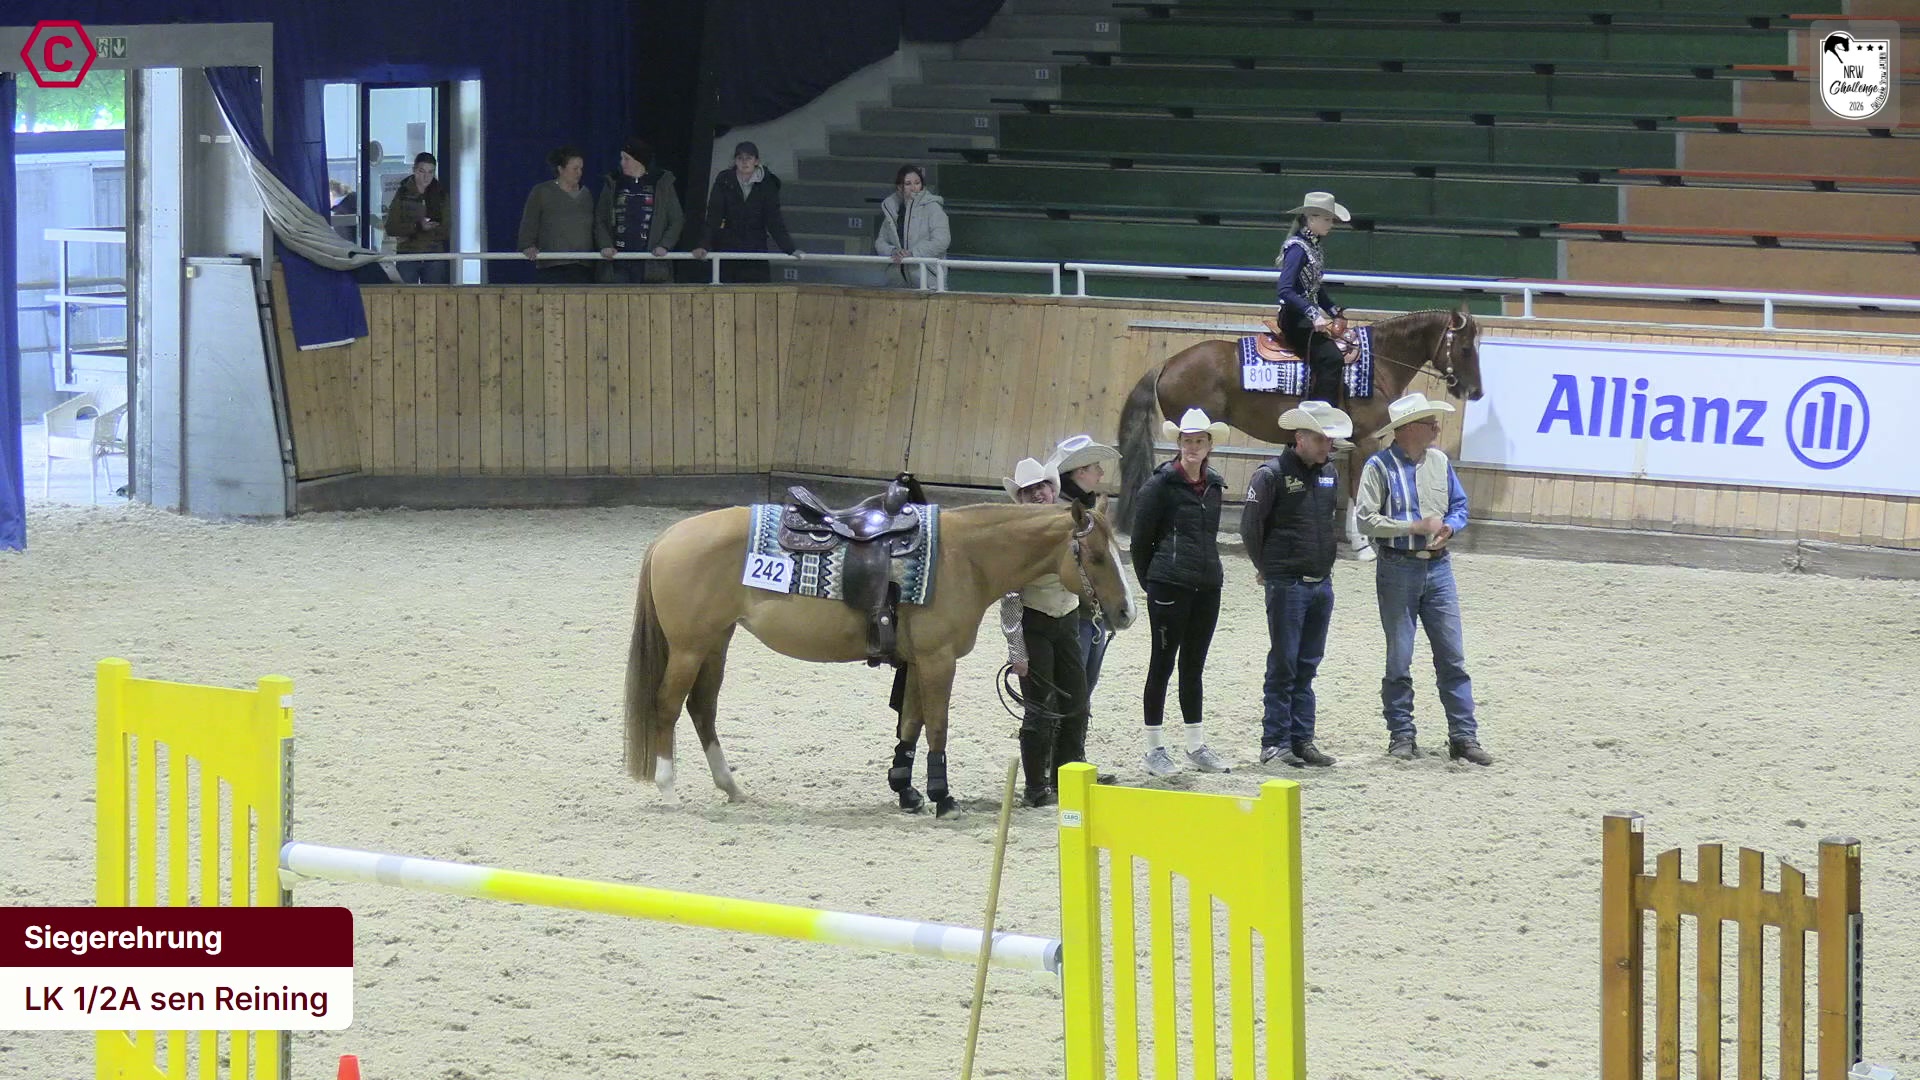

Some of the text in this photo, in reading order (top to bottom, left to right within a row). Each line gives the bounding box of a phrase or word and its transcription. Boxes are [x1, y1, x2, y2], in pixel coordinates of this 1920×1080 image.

[1250, 368, 1272, 382] 810
[1536, 373, 1768, 447] Allianz
[751, 558, 785, 583] 242
